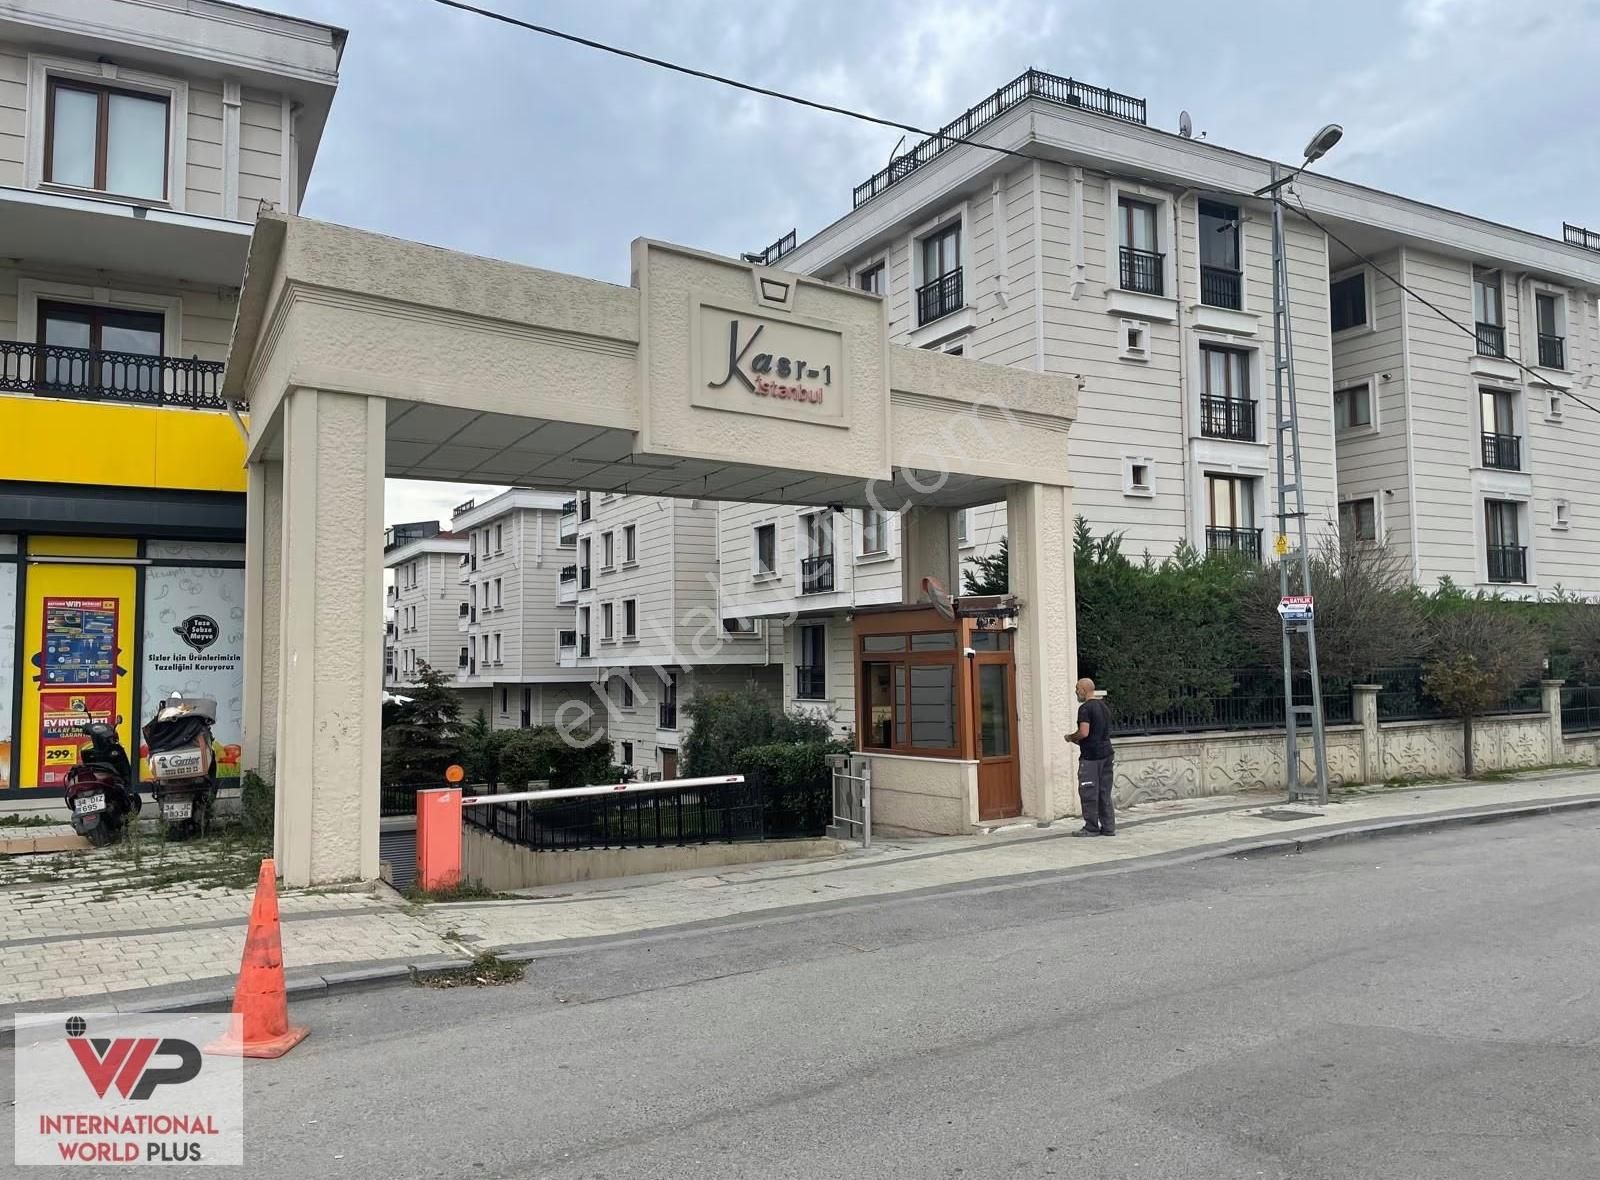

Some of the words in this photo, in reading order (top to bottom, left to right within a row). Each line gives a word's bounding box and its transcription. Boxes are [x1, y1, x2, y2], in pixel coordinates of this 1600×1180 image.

[188, 652, 241, 661] Ürünlerimizin
[154, 663, 193, 672] Tazeliğini
[195, 663, 235, 671] Koruyoruz
